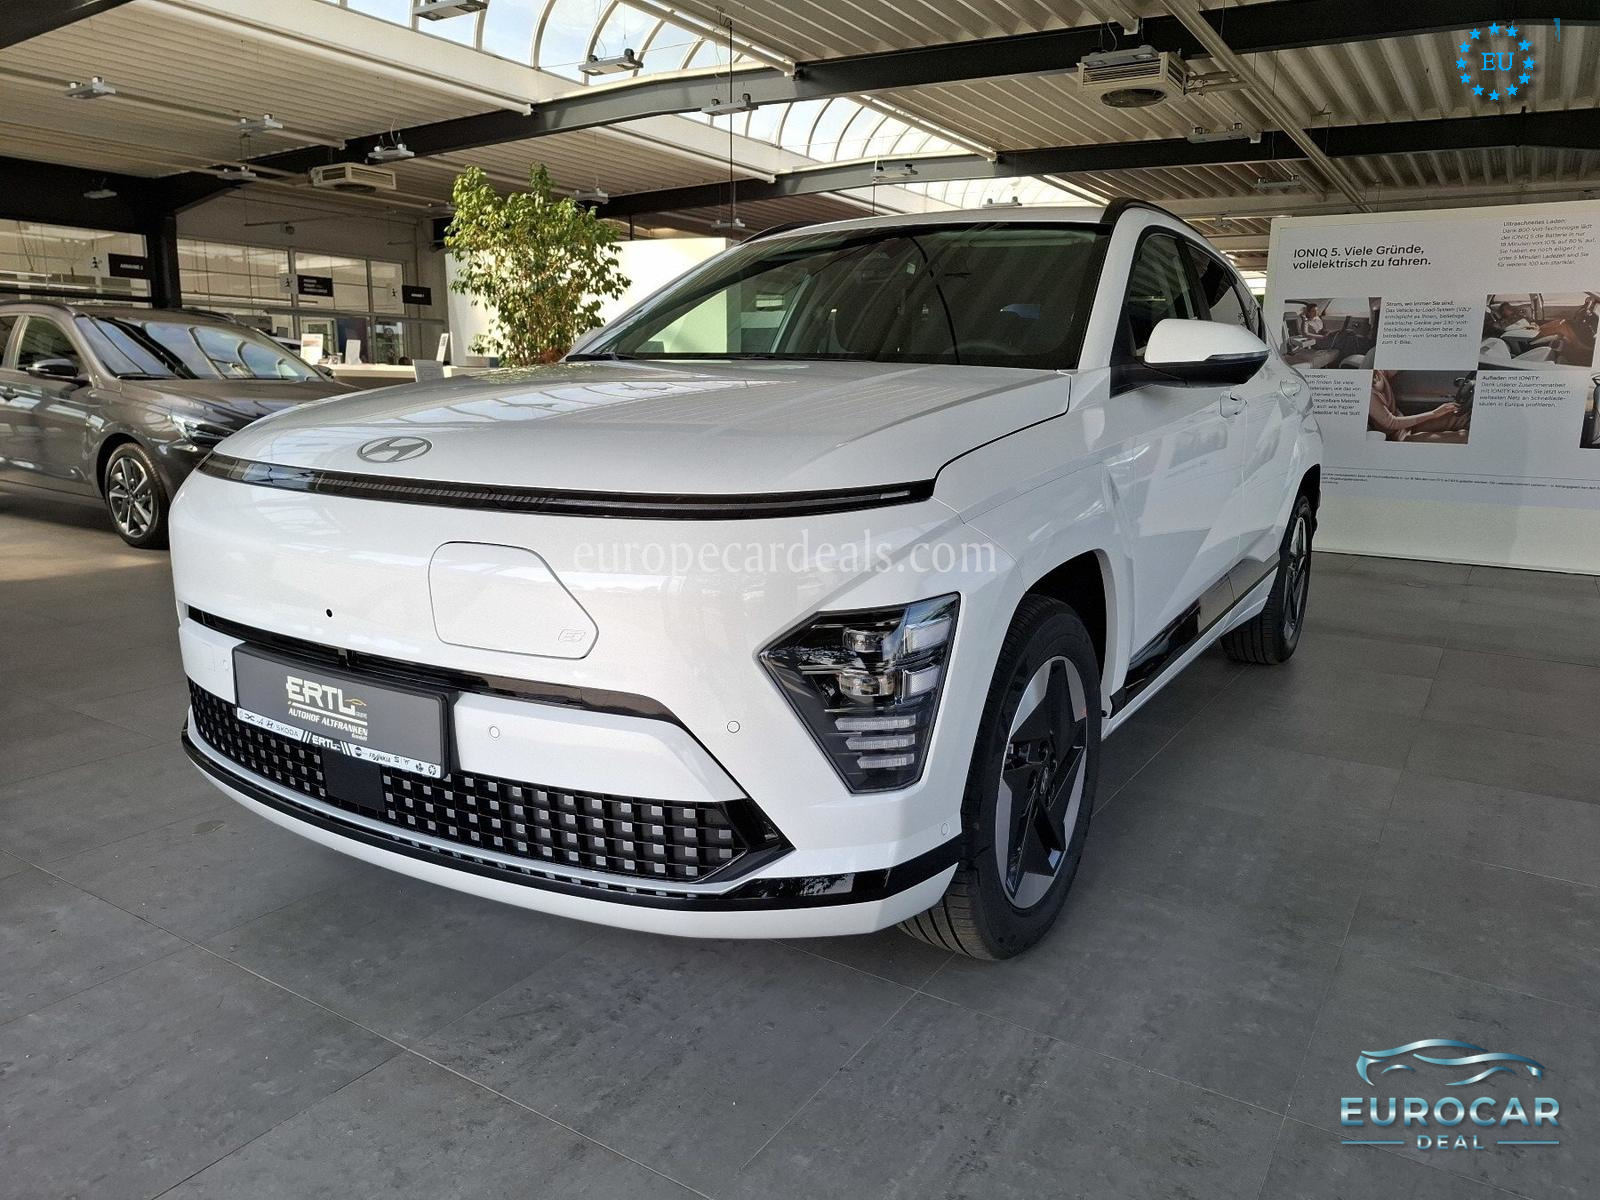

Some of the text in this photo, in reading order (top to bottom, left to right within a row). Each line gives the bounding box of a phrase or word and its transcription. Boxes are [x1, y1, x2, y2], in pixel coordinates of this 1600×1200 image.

[1294, 244, 1424, 258] IONIQ 5. Viele Gründe,
[1293, 258, 1368, 269] vollelektrisch
[1388, 257, 1431, 267] fahren.
[286, 676, 356, 716] ERTL
[288, 707, 368, 736] AUTOHOF ALTFRANKEN
[312, 734, 337, 750] ERTL
